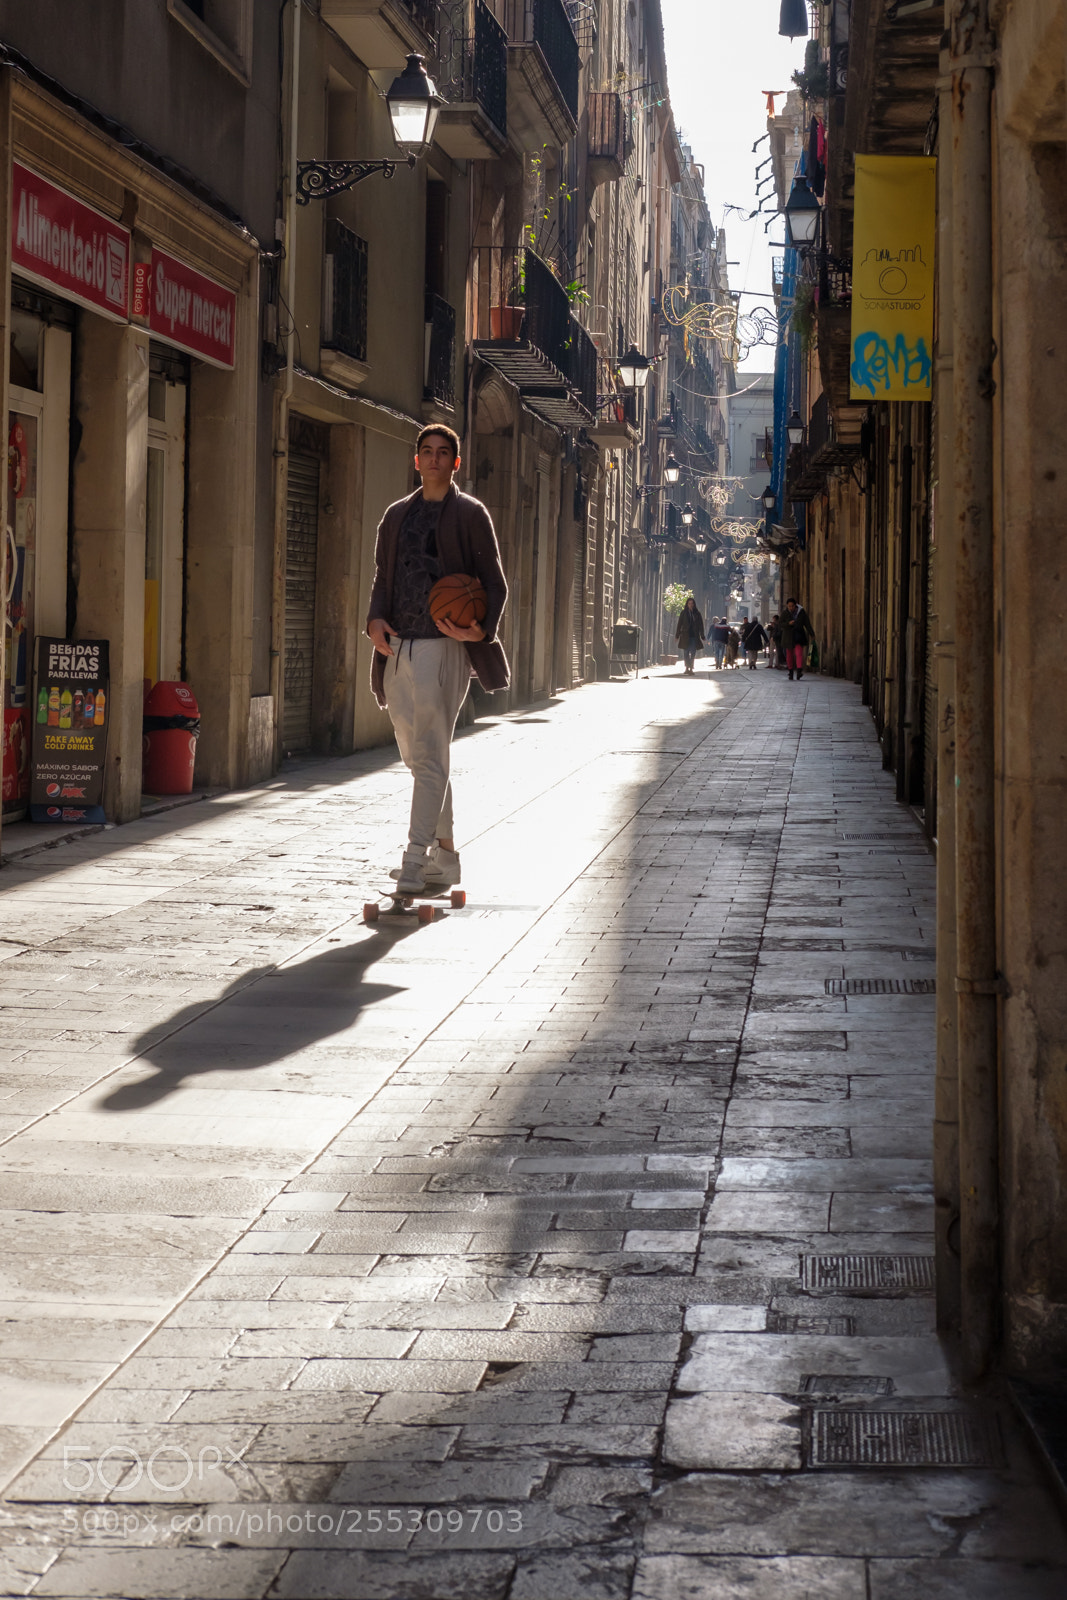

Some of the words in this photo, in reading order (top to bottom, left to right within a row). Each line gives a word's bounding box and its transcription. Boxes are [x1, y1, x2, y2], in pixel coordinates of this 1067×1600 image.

[16, 188, 106, 292] Alimentació
[135, 268, 145, 299] FRIGO
[155, 261, 193, 334] Super
[193, 297, 232, 348] mercat
[49, 644, 100, 656] BEBIDAS
[48, 655, 99, 672] FRÍAS
[48, 671, 69, 679] PARA
[70, 672, 99, 680] LLEVAR
[45, 735, 67, 743] TAKE
[69, 736, 95, 744] AWAY
[67, 743, 94, 751] DRINKS
[36, 763, 70, 771] MÁXIMO
